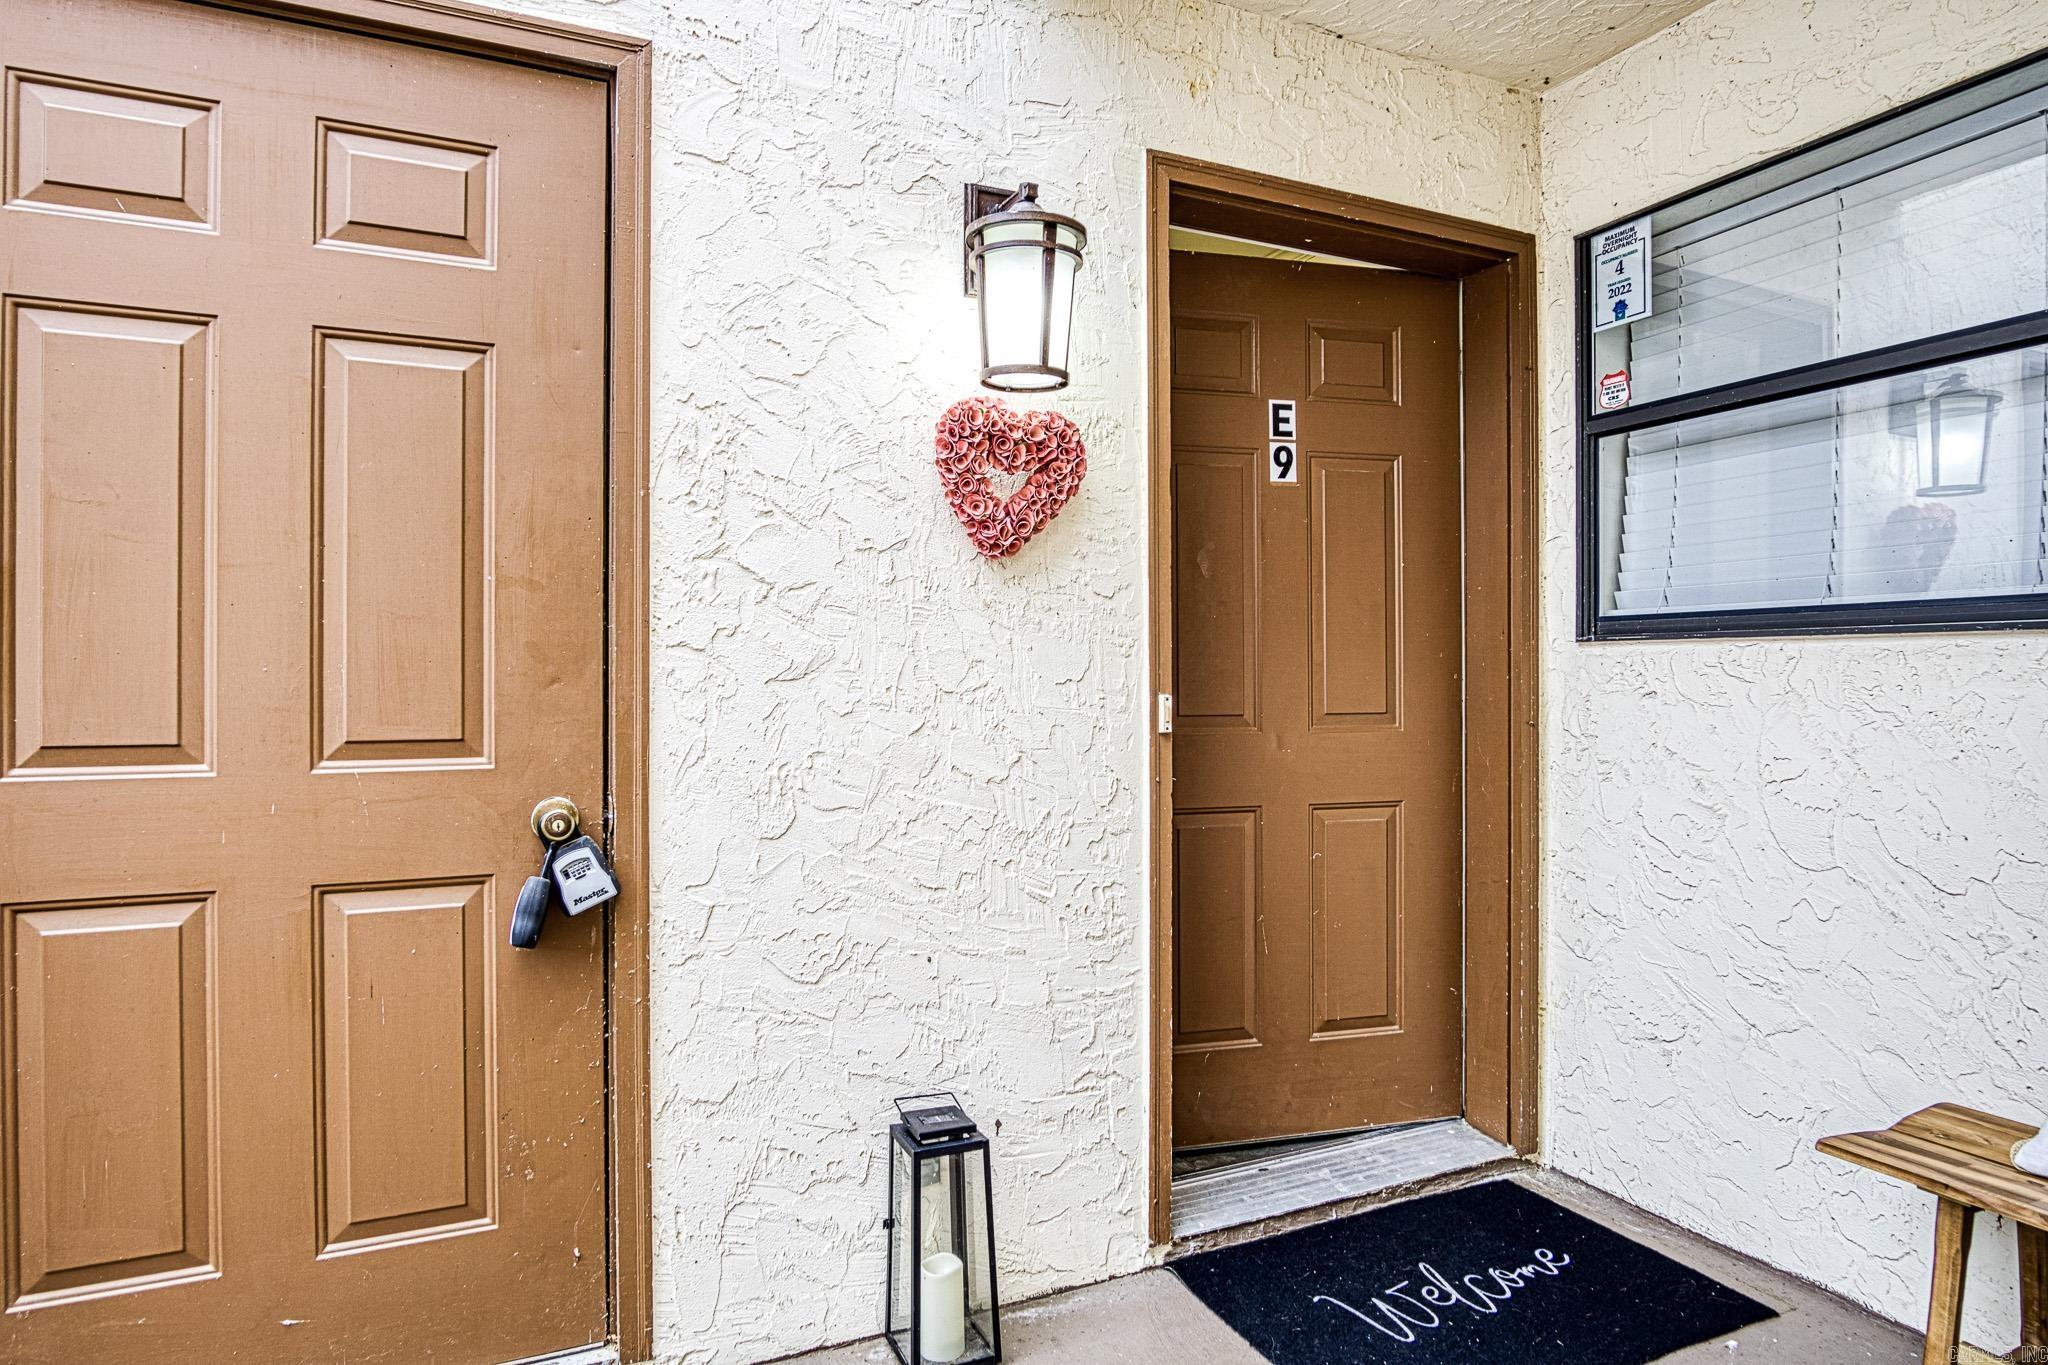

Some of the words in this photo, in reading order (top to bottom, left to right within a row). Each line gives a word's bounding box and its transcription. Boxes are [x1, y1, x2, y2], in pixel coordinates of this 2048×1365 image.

[1602, 231, 1638, 249] OVERNIGHT
[1604, 225, 1636, 242] MAXIMUM
[1601, 237, 1638, 255] OCCUPANCY
[1614, 259, 1625, 275] 4
[1607, 282, 1632, 300] 2022
[1272, 403, 1293, 437] E
[1273, 445, 1293, 479] 9
[573, 887, 606, 906] Master
[1312, 1248, 1570, 1342] Welcome
